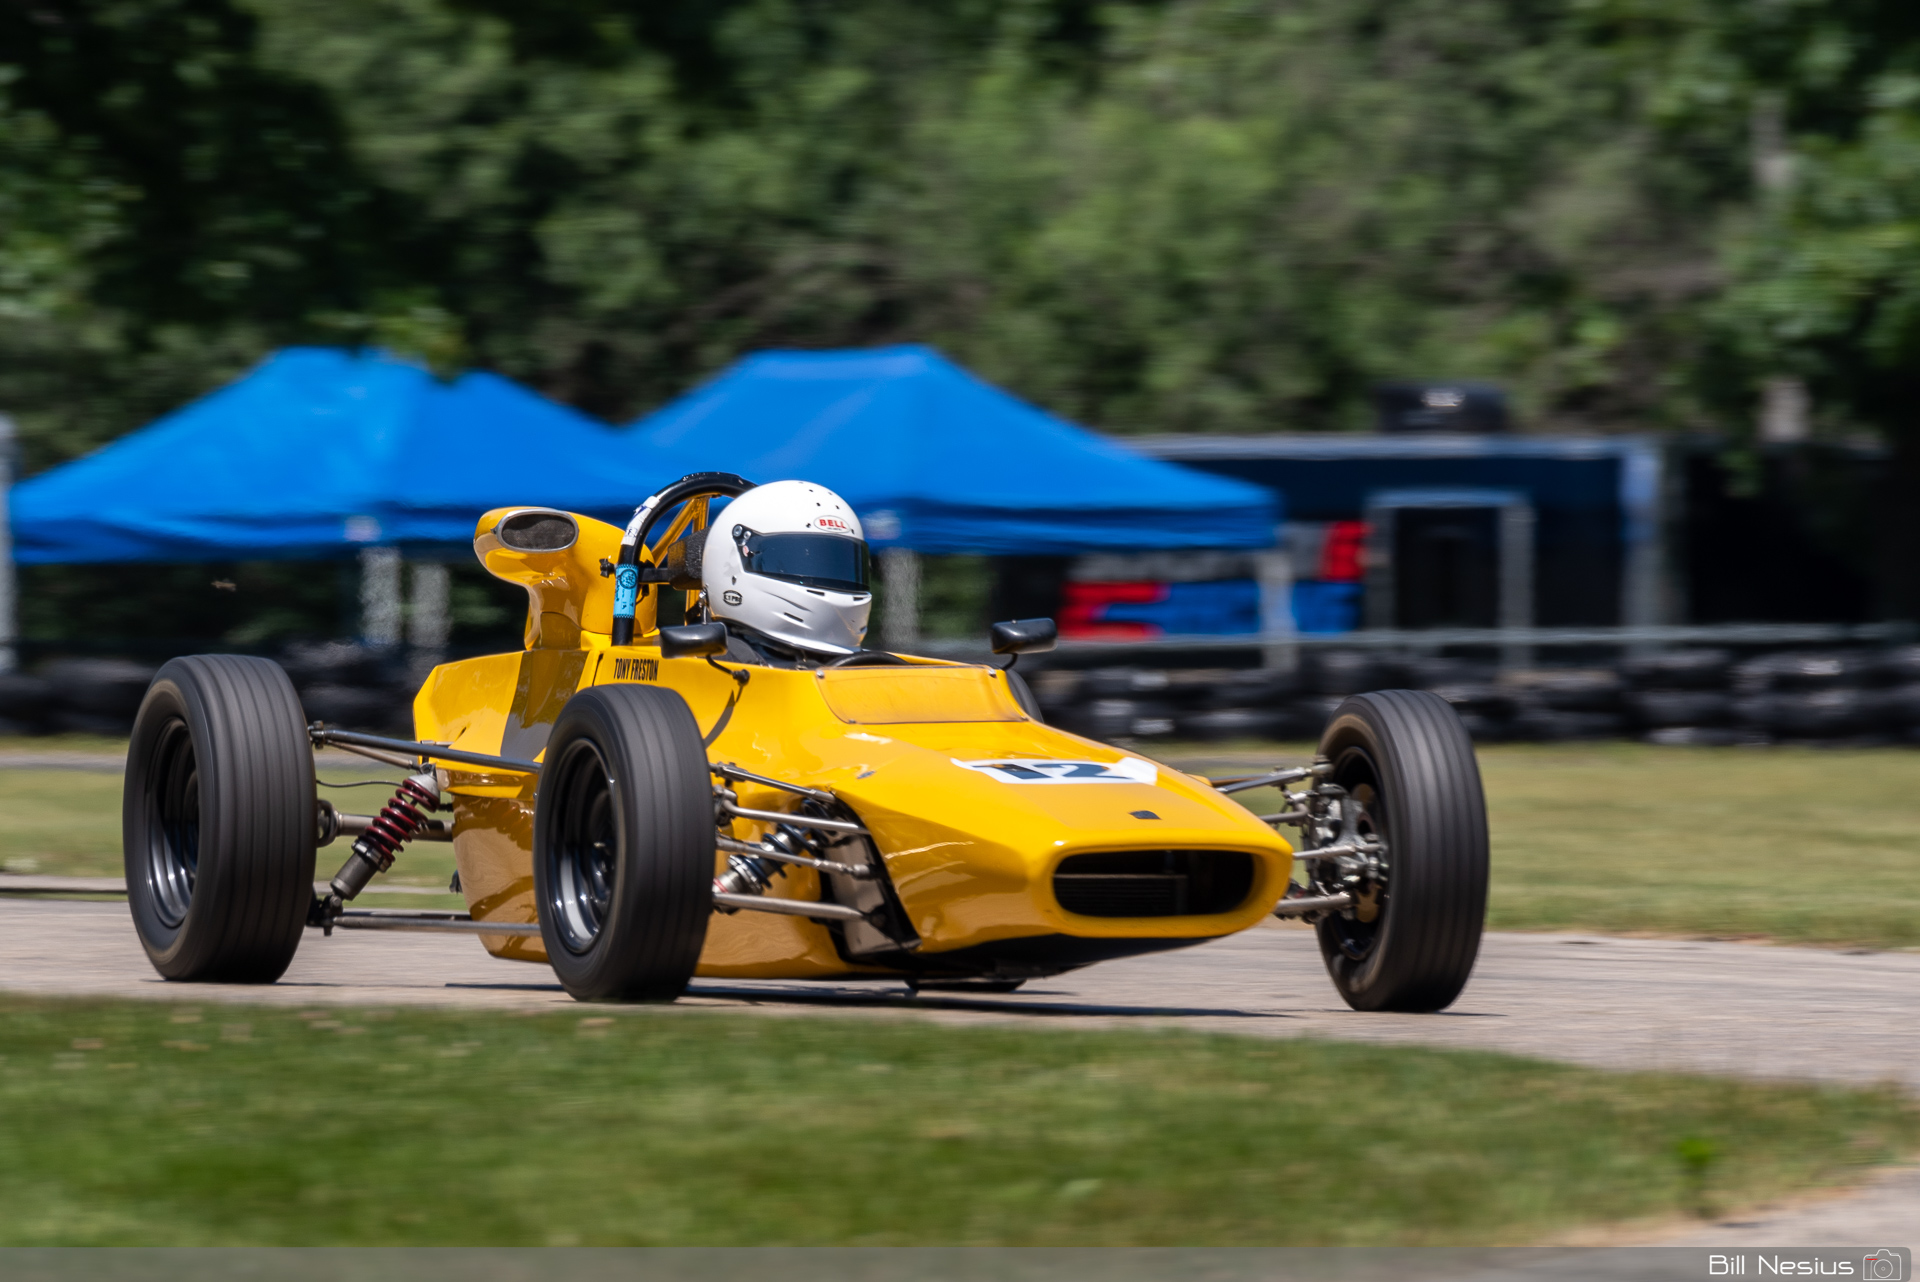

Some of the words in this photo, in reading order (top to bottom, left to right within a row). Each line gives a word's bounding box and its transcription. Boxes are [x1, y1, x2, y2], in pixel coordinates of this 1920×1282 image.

[819, 518, 847, 529] BELL
[613, 658, 632, 680] TONY
[630, 658, 660, 681] FRESTON
[972, 763, 1134, 780] 12
